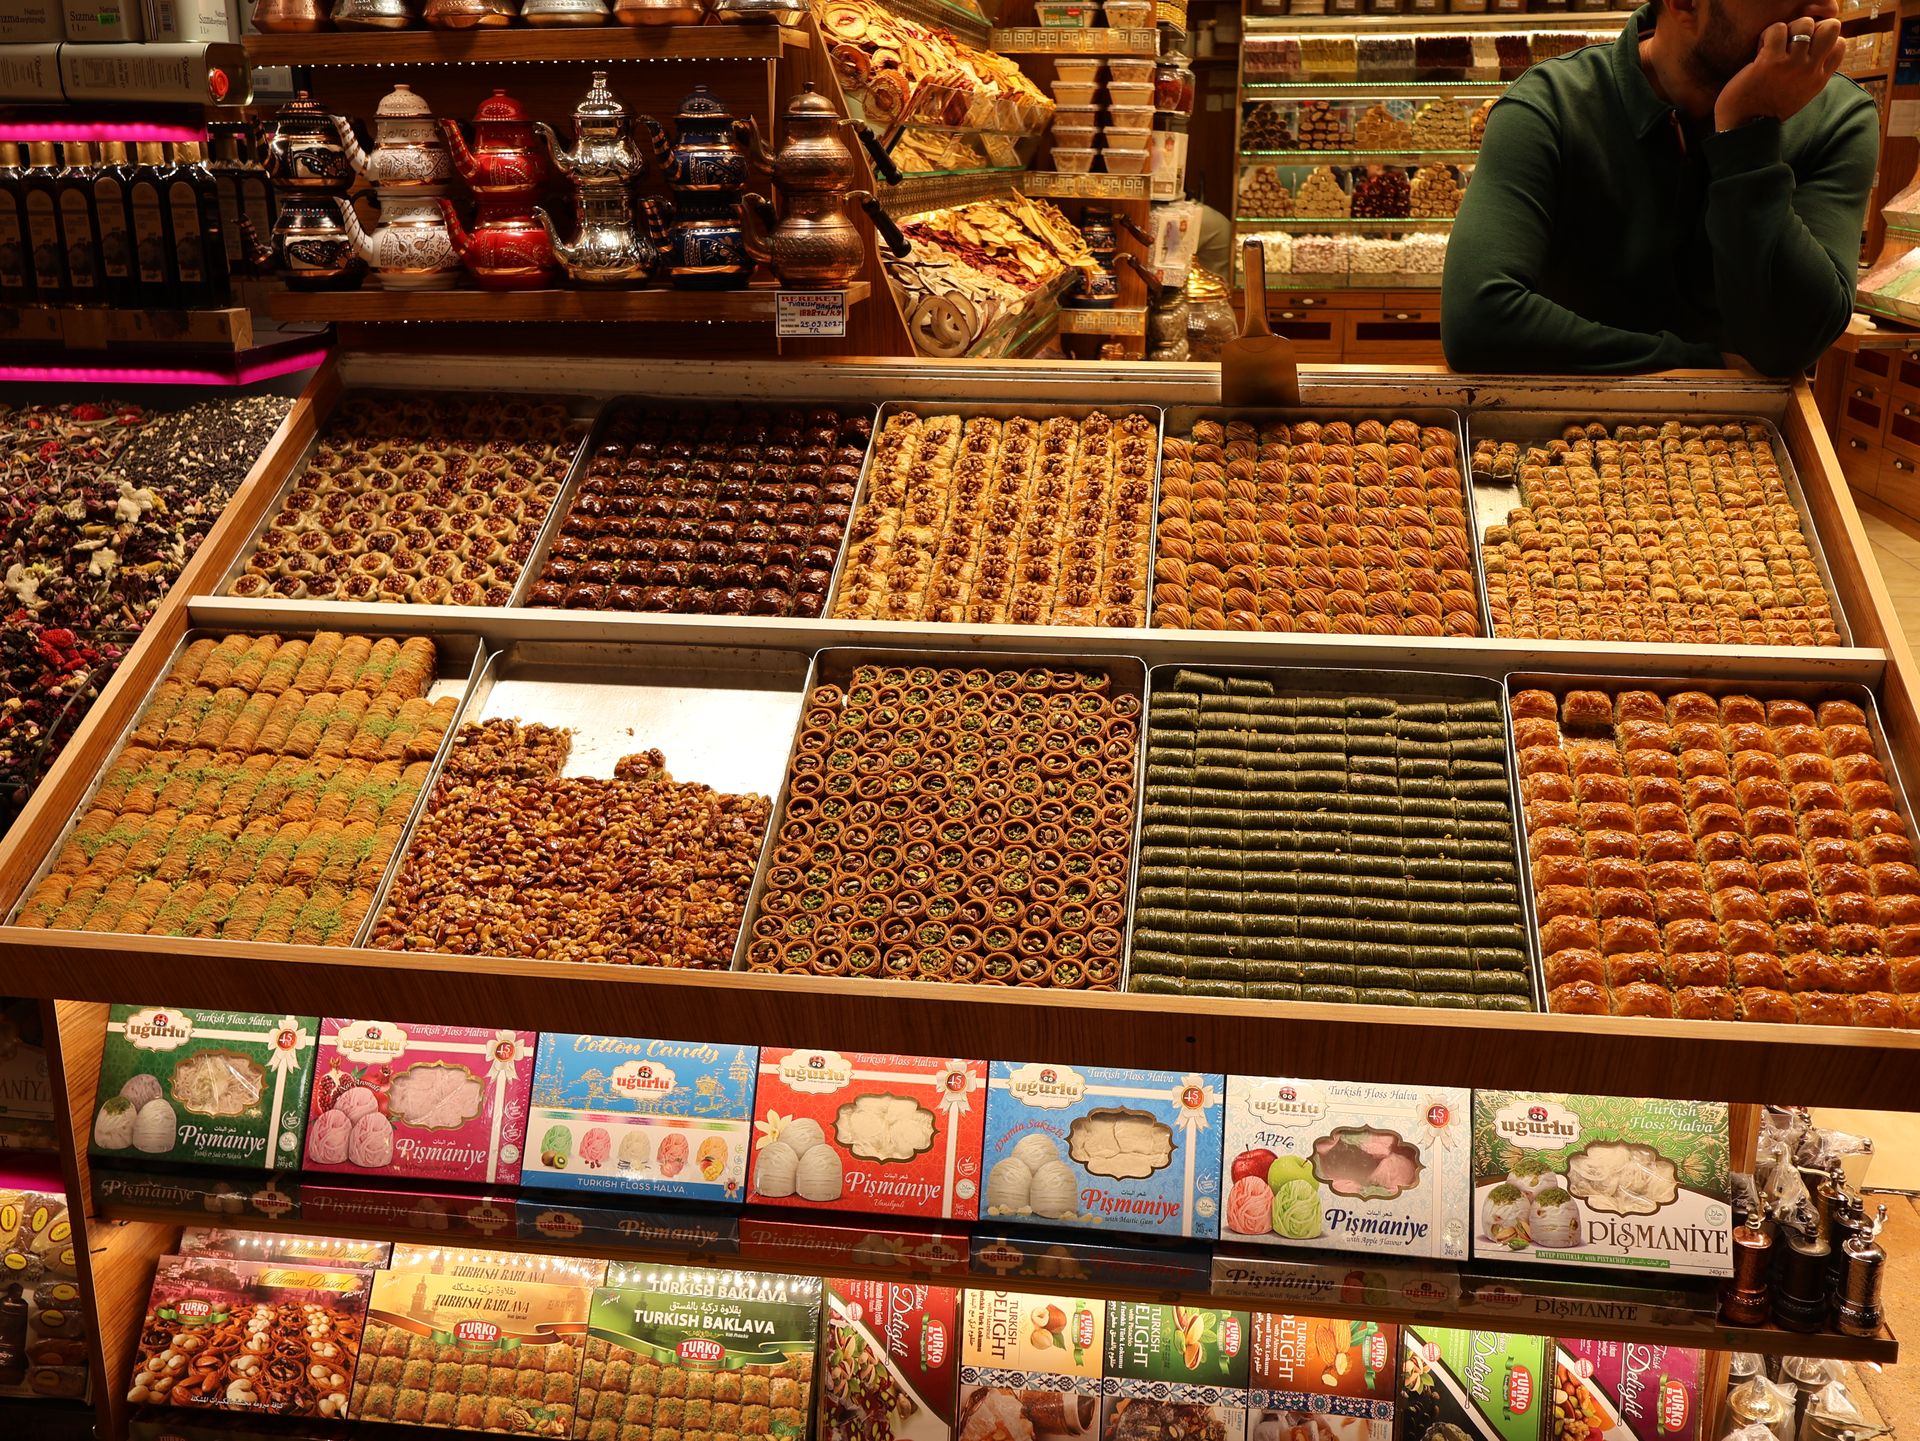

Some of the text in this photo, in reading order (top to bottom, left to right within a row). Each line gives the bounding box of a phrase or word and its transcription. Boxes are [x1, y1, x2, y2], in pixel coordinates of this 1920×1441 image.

[195, 1012, 273, 1027] Turkish Floss Halva
[130, 1023, 186, 1039] uğurlu
[279, 1033, 293, 1045] 45
[410, 1024, 488, 1038] Turkish Floss Halva
[342, 1036, 400, 1052] uğurlu
[497, 1045, 511, 1055] 45
[574, 1035, 720, 1064] Cotton Candy
[855, 1053, 939, 1068] Turkish Floss Halva
[616, 1074, 670, 1091] uğurlu
[785, 1065, 845, 1083] uğurlu
[948, 1075, 962, 1086] 45
[1087, 1068, 1174, 1083] Turkish Floss Halva
[1015, 1079, 1078, 1096] uğurlu
[1184, 1090, 1199, 1102] 45
[1328, 1085, 1418, 1101] Turkish Floss Halva
[1254, 1098, 1320, 1115] uğurlu
[1429, 1108, 1445, 1120] 45
[1645, 1102, 1698, 1117] Turkish
[1501, 1118, 1575, 1136] uğurlu
[1630, 1117, 1714, 1133] Floss Halva
[178, 1125, 266, 1158] Pişmaniye
[1254, 1131, 1295, 1150] Apple
[396, 1138, 486, 1170] Pişmaniye
[101, 1180, 195, 1204] Pişmaniye
[577, 1178, 686, 1194] TURKISH FLOSS HALVA
[845, 1171, 941, 1205] Pişmaniye
[313, 1196, 408, 1221] Pişmaniye
[1081, 1189, 1182, 1224] Pişmaniye
[539, 1221, 580, 1233] uğurlu
[618, 1219, 719, 1247] Pişmaniye
[1325, 1209, 1428, 1245] Pişmaniye
[1588, 1218, 1729, 1254] PİŞMANİYE
[751, 1231, 851, 1256] Pişmaniye
[1361, 1237, 1378, 1247] Apple
[982, 1253, 1020, 1263] uğurlu
[453, 1266, 499, 1280] TURKISH
[1226, 1269, 1335, 1295] Pişmaniye
[308, 1275, 352, 1291] Dessert
[651, 1280, 788, 1303] TURKISH BAKLAVA
[1405, 1287, 1446, 1299] uğurlu
[179, 1302, 209, 1313] TURKO
[434, 1294, 530, 1313] TURKISH BAKLAVA
[1534, 1297, 1638, 1319] PİŞMANİYE
[460, 1322, 497, 1335] TURKO
[634, 1310, 776, 1335] TURKISH BAKLAVA
[885, 1286, 914, 1358] Delight
[1008, 1301, 1019, 1346] TURKISH
[1083, 1315, 1093, 1345] TURKO
[1150, 1307, 1162, 1353] TURKISH
[459, 1333, 494, 1341] BABA
[932, 1326, 944, 1363] TURKO
[1133, 1303, 1150, 1368] ELIGHT
[1229, 1322, 1239, 1353] TURKO
[1296, 1321, 1307, 1367] TURKISH
[682, 1341, 720, 1355] TURKO
[682, 1352, 718, 1360] BABA
[1118, 1343, 1126, 1369] Lokumu
[1375, 1337, 1385, 1368] TURKO
[1464, 1331, 1499, 1401] Delight
[1510, 1371, 1518, 1407] BABA
[1515, 1371, 1529, 1410] TURKO
[1617, 1343, 1651, 1419] Delight
[1671, 1388, 1685, 1427] TURKO
